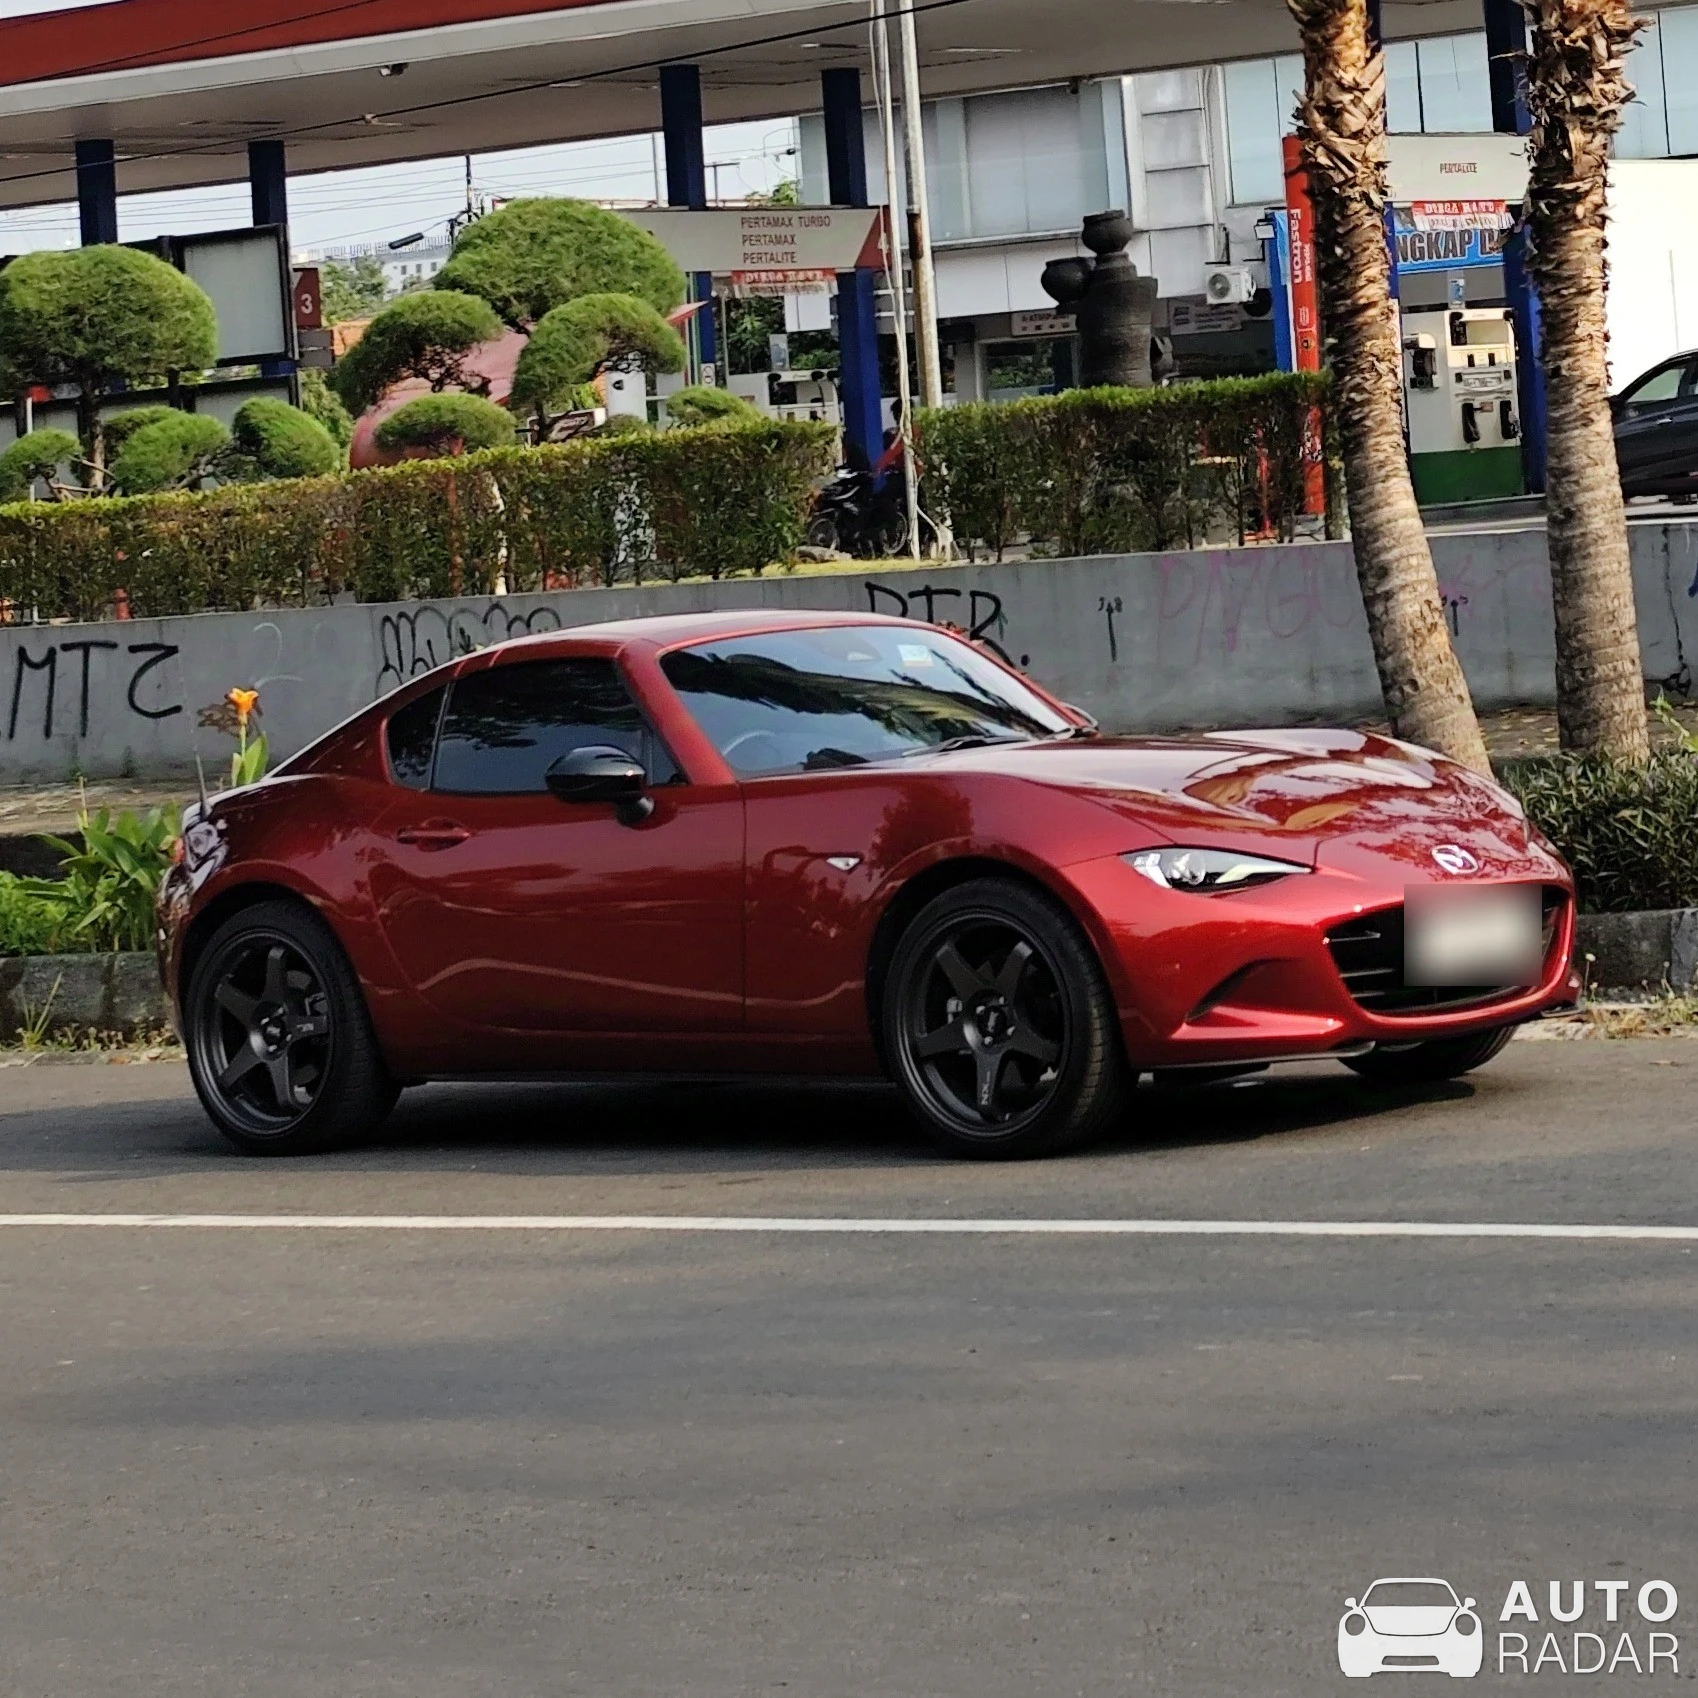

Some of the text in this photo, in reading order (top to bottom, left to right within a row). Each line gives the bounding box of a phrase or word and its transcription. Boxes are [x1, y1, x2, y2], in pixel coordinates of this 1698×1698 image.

[741, 215, 831, 229] PERTAMAX TURBO
[741, 234, 796, 247] PERTAMAX
[1290, 208, 1303, 284] Fastron
[743, 251, 797, 264] PERTALITE
[301, 293, 313, 314] 3
